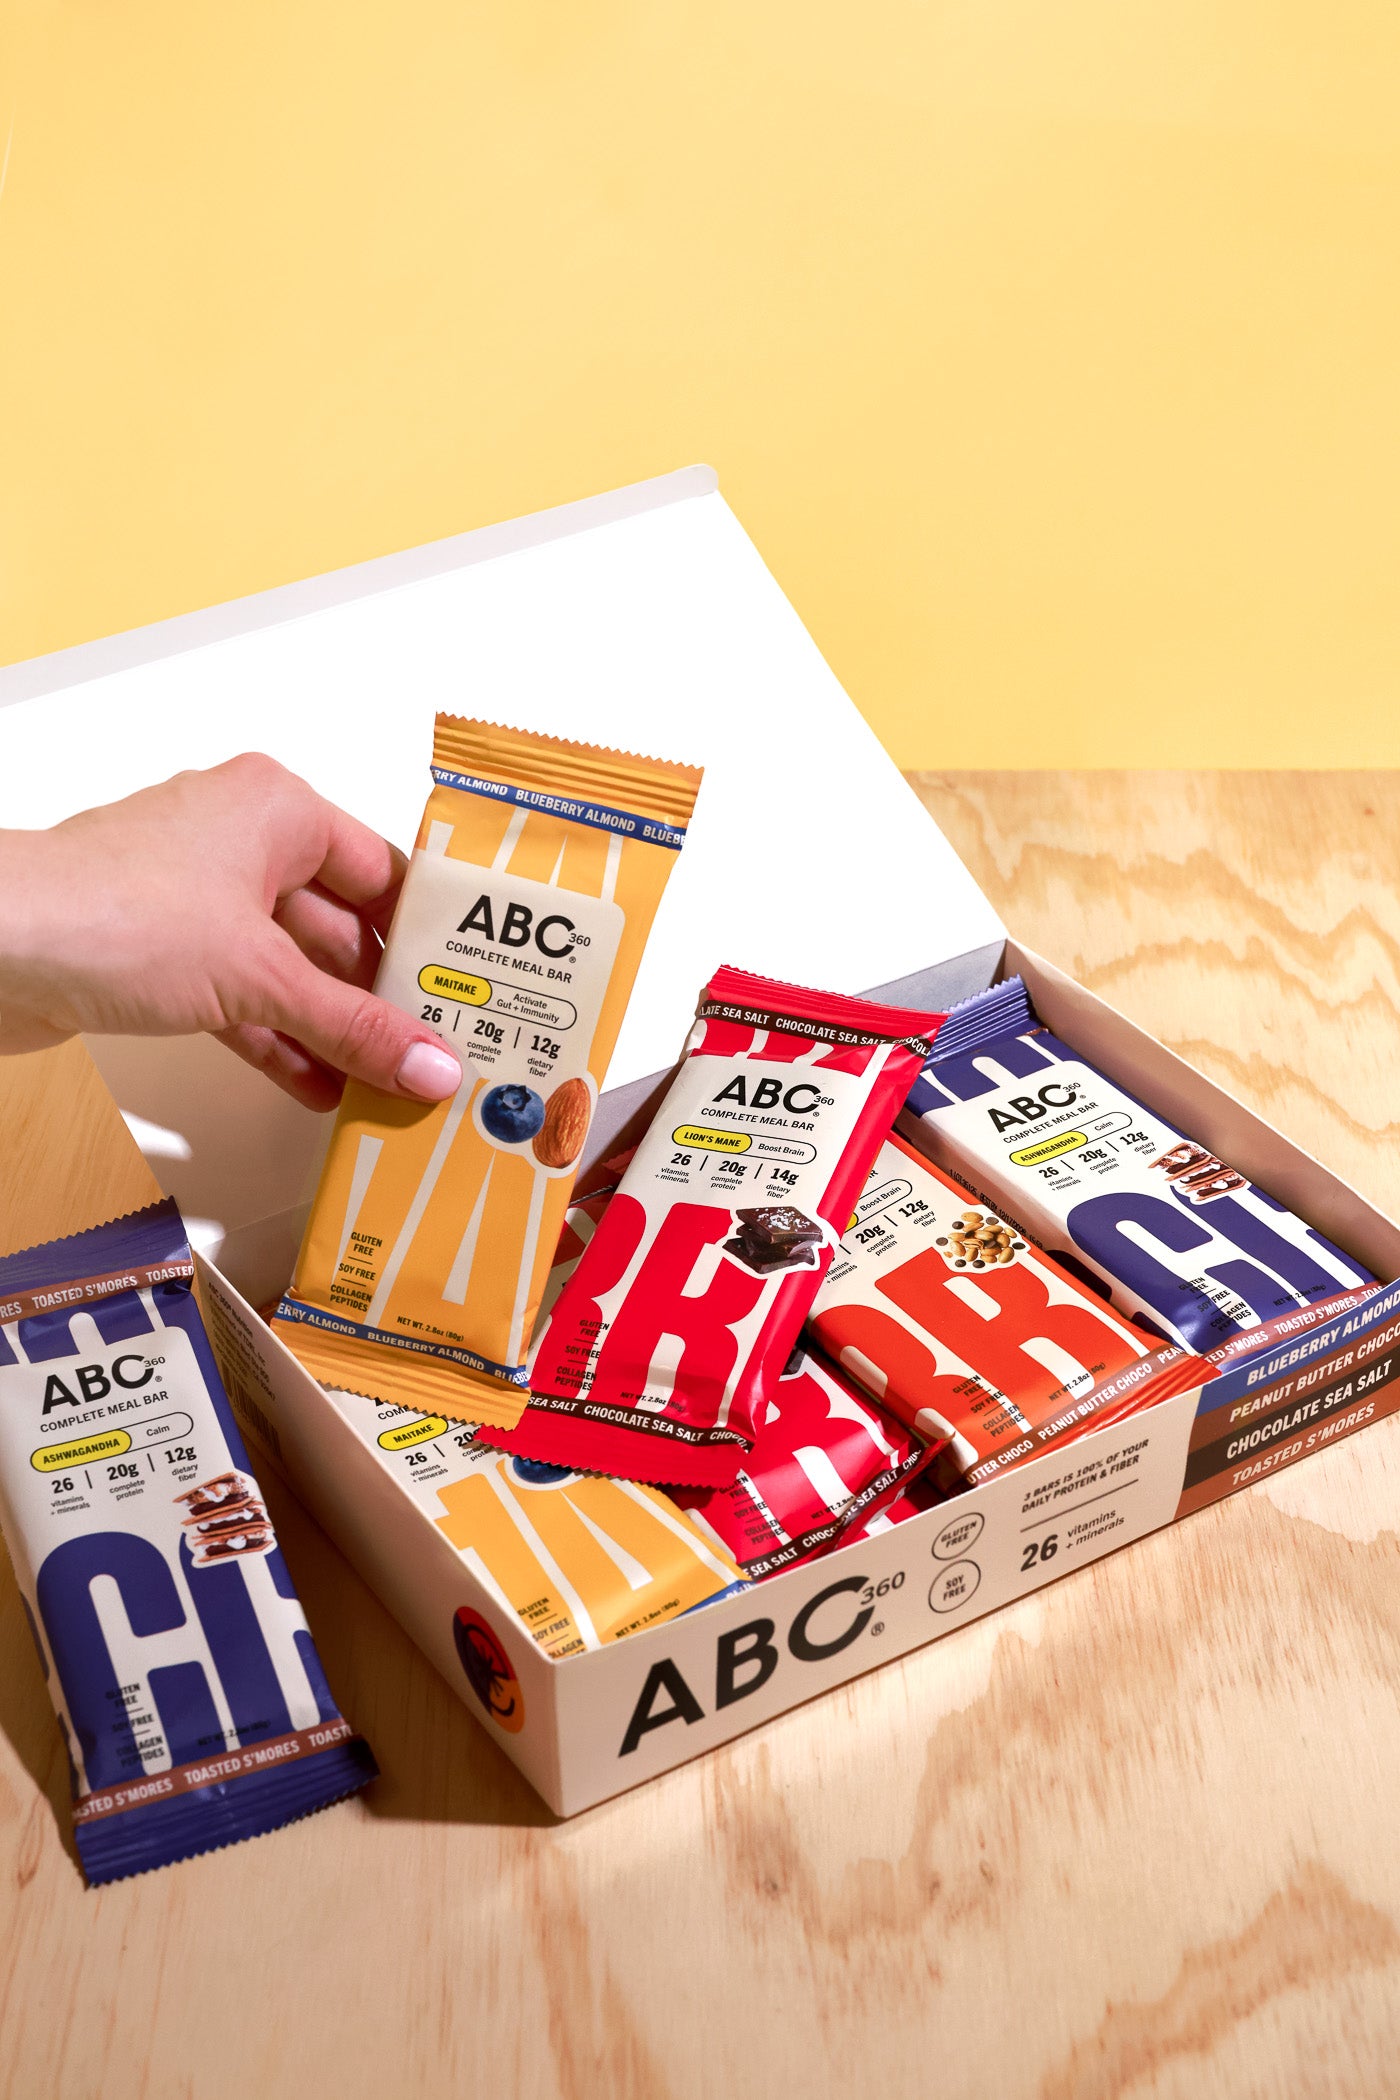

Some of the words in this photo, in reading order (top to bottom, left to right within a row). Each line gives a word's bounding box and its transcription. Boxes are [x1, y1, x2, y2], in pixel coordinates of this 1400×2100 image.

[457, 775, 508, 796] ALMOND
[515, 789, 584, 817] BLUEBERRY
[585, 809, 636, 832] ALMOND
[446, 940, 509, 967] COMPLETE
[512, 959, 543, 977] MEAL
[546, 968, 572, 984] BAR
[434, 975, 477, 996] MAITAKE
[513, 993, 547, 1009] Activate
[420, 1004, 443, 1023] 26
[496, 999, 512, 1011] Gut
[520, 1005, 560, 1024] Immunity
[722, 1007, 742, 1019] SEA
[744, 1011, 769, 1025] SALT
[474, 1019, 505, 1044] 20g
[775, 1017, 836, 1041] CHOCOLATE
[837, 1030, 858, 1044] SEA
[467, 1040, 501, 1056] complete
[531, 1035, 561, 1059] 12g
[468, 1051, 495, 1064] protein
[527, 1057, 553, 1071] dietary
[700, 1107, 757, 1124] COMPLETE
[759, 1115, 790, 1128] MEAL
[792, 1119, 815, 1131] BAR
[1003, 1120, 1053, 1144] COMPLETE
[1053, 1108, 1080, 1126] MEAL
[1078, 1101, 1099, 1116] BAR
[1094, 1119, 1114, 1132] Calm
[684, 1130, 714, 1144] LION'S
[715, 1135, 742, 1148] MANE
[1119, 1130, 1149, 1145] 12g
[758, 1142, 781, 1154] Boost
[783, 1146, 805, 1157] Brain
[1020, 1135, 1078, 1163] ASHWAGANDHA
[1078, 1147, 1108, 1164] 20g
[671, 1152, 692, 1166] 26
[718, 1159, 747, 1177] 20g
[661, 1166, 690, 1177] vitamins
[662, 1174, 689, 1185] minerals
[711, 1175, 743, 1186] complete
[770, 1167, 799, 1186] 14g
[1038, 1166, 1060, 1179] 26
[710, 1181, 736, 1192] protein
[765, 1183, 791, 1195] dietary
[859, 1194, 883, 1212] Boost
[880, 1185, 902, 1201] Brain
[898, 1199, 929, 1219] 12g
[913, 1209, 935, 1226] dietary
[351, 1231, 383, 1248] GLUTEN
[855, 1224, 886, 1245] 20g
[866, 1233, 895, 1254] complete
[353, 1243, 374, 1257] FREE
[875, 1239, 898, 1257] protein
[146, 1264, 195, 1283] TOASTED
[338, 1262, 354, 1275] SOY
[354, 1266, 376, 1281] FREE
[830, 1263, 858, 1282] minerals
[32, 1285, 83, 1310] TOASTED
[85, 1274, 138, 1298] S'MORES
[330, 1284, 373, 1302] COLLAGEN
[1212, 1290, 1231, 1304] FREE
[0, 1301, 23, 1319] RES
[330, 1294, 369, 1313] PEPTIDES
[277, 1302, 306, 1321] ERRY
[307, 1314, 357, 1335] ALMOND
[1274, 1310, 1316, 1335] TOASTED
[1315, 1295, 1358, 1320] S'MORES
[579, 1319, 610, 1331] GLUTEN
[1225, 1331, 1269, 1356] S'MORES
[1247, 1331, 1341, 1386] BLUEBERRY
[1342, 1291, 1400, 1338] ALMOND
[367, 1331, 436, 1353] BLUEBERRY
[437, 1347, 485, 1372] ALMOND
[556, 1365, 597, 1382] COLLAGEN
[1229, 1385, 1294, 1423] PEANUT
[1296, 1351, 1354, 1392] BUTTER
[1357, 1327, 1400, 1360] CHOCO
[555, 1376, 593, 1392] PEPTIDES
[952, 1374, 982, 1394] GLUTEN
[963, 1384, 984, 1398] FREE
[528, 1396, 548, 1407] SEA
[550, 1399, 578, 1412] SALT
[970, 1400, 986, 1414] SOY
[985, 1390, 1004, 1406] FREE
[1037, 1412, 1077, 1441] PEANUT
[1079, 1384, 1120, 1418] BUTTER
[1116, 1362, 1153, 1391] CHOCO
[1226, 1399, 1321, 1460] CHOCOLATE
[1323, 1384, 1353, 1409] SEA
[1357, 1360, 1392, 1392] SALT
[40, 1408, 105, 1434] COMPLETE
[107, 1398, 144, 1417] MEAL
[143, 1390, 169, 1406] BAR
[982, 1404, 1020, 1431] COLLAGEN
[146, 1423, 170, 1437] Calm
[583, 1405, 651, 1428] CHOCOLATE
[651, 1420, 674, 1435] SEA
[675, 1427, 703, 1442] SALT
[990, 1412, 1025, 1438] PEPTIDES
[393, 1423, 434, 1444] MAITAKE
[42, 1437, 121, 1465] ASHWAGANDHA
[997, 1438, 1034, 1465] CHOCO
[1232, 1440, 1303, 1486] TOASTED
[1305, 1402, 1376, 1449] S'MORES
[164, 1445, 198, 1465] 12g
[405, 1451, 428, 1467] 26
[106, 1462, 139, 1484] 20g
[171, 1463, 199, 1478] dietary
[410, 1463, 441, 1477] vitamins
[1023, 1492, 1031, 1501] 3
[1033, 1478, 1061, 1498] BARS
[1062, 1472, 1074, 1484] IS
[1077, 1458, 1104, 1479] 100%
[1106, 1451, 1120, 1464] OF
[1121, 1439, 1149, 1458] YOUR
[51, 1477, 75, 1494] 26
[109, 1479, 146, 1495] complete
[856, 1487, 876, 1507] SEA
[874, 1470, 899, 1493] SALT
[1021, 1494, 1051, 1513] DAILY
[1053, 1474, 1098, 1500] PROTEIN
[1099, 1469, 1108, 1480] &
[1109, 1455, 1139, 1477] FIBER
[50, 1494, 85, 1508] vitamins
[115, 1486, 145, 1502] protein
[941, 1520, 977, 1543] GLUTEN
[1066, 1509, 1116, 1538] vitamins
[1075, 1517, 1125, 1546] minerals
[945, 1532, 970, 1548] FREE
[750, 1562, 772, 1577] SEA
[771, 1547, 799, 1567] SALT
[1020, 1534, 1059, 1573] 26
[945, 1574, 964, 1590] SOY
[943, 1584, 966, 1601] FREE
[549, 1617, 570, 1634] FREE
[184, 1759, 241, 1785] TOASTED
[243, 1740, 300, 1769] S'MORES
[114, 1777, 173, 1806] S'MORES
